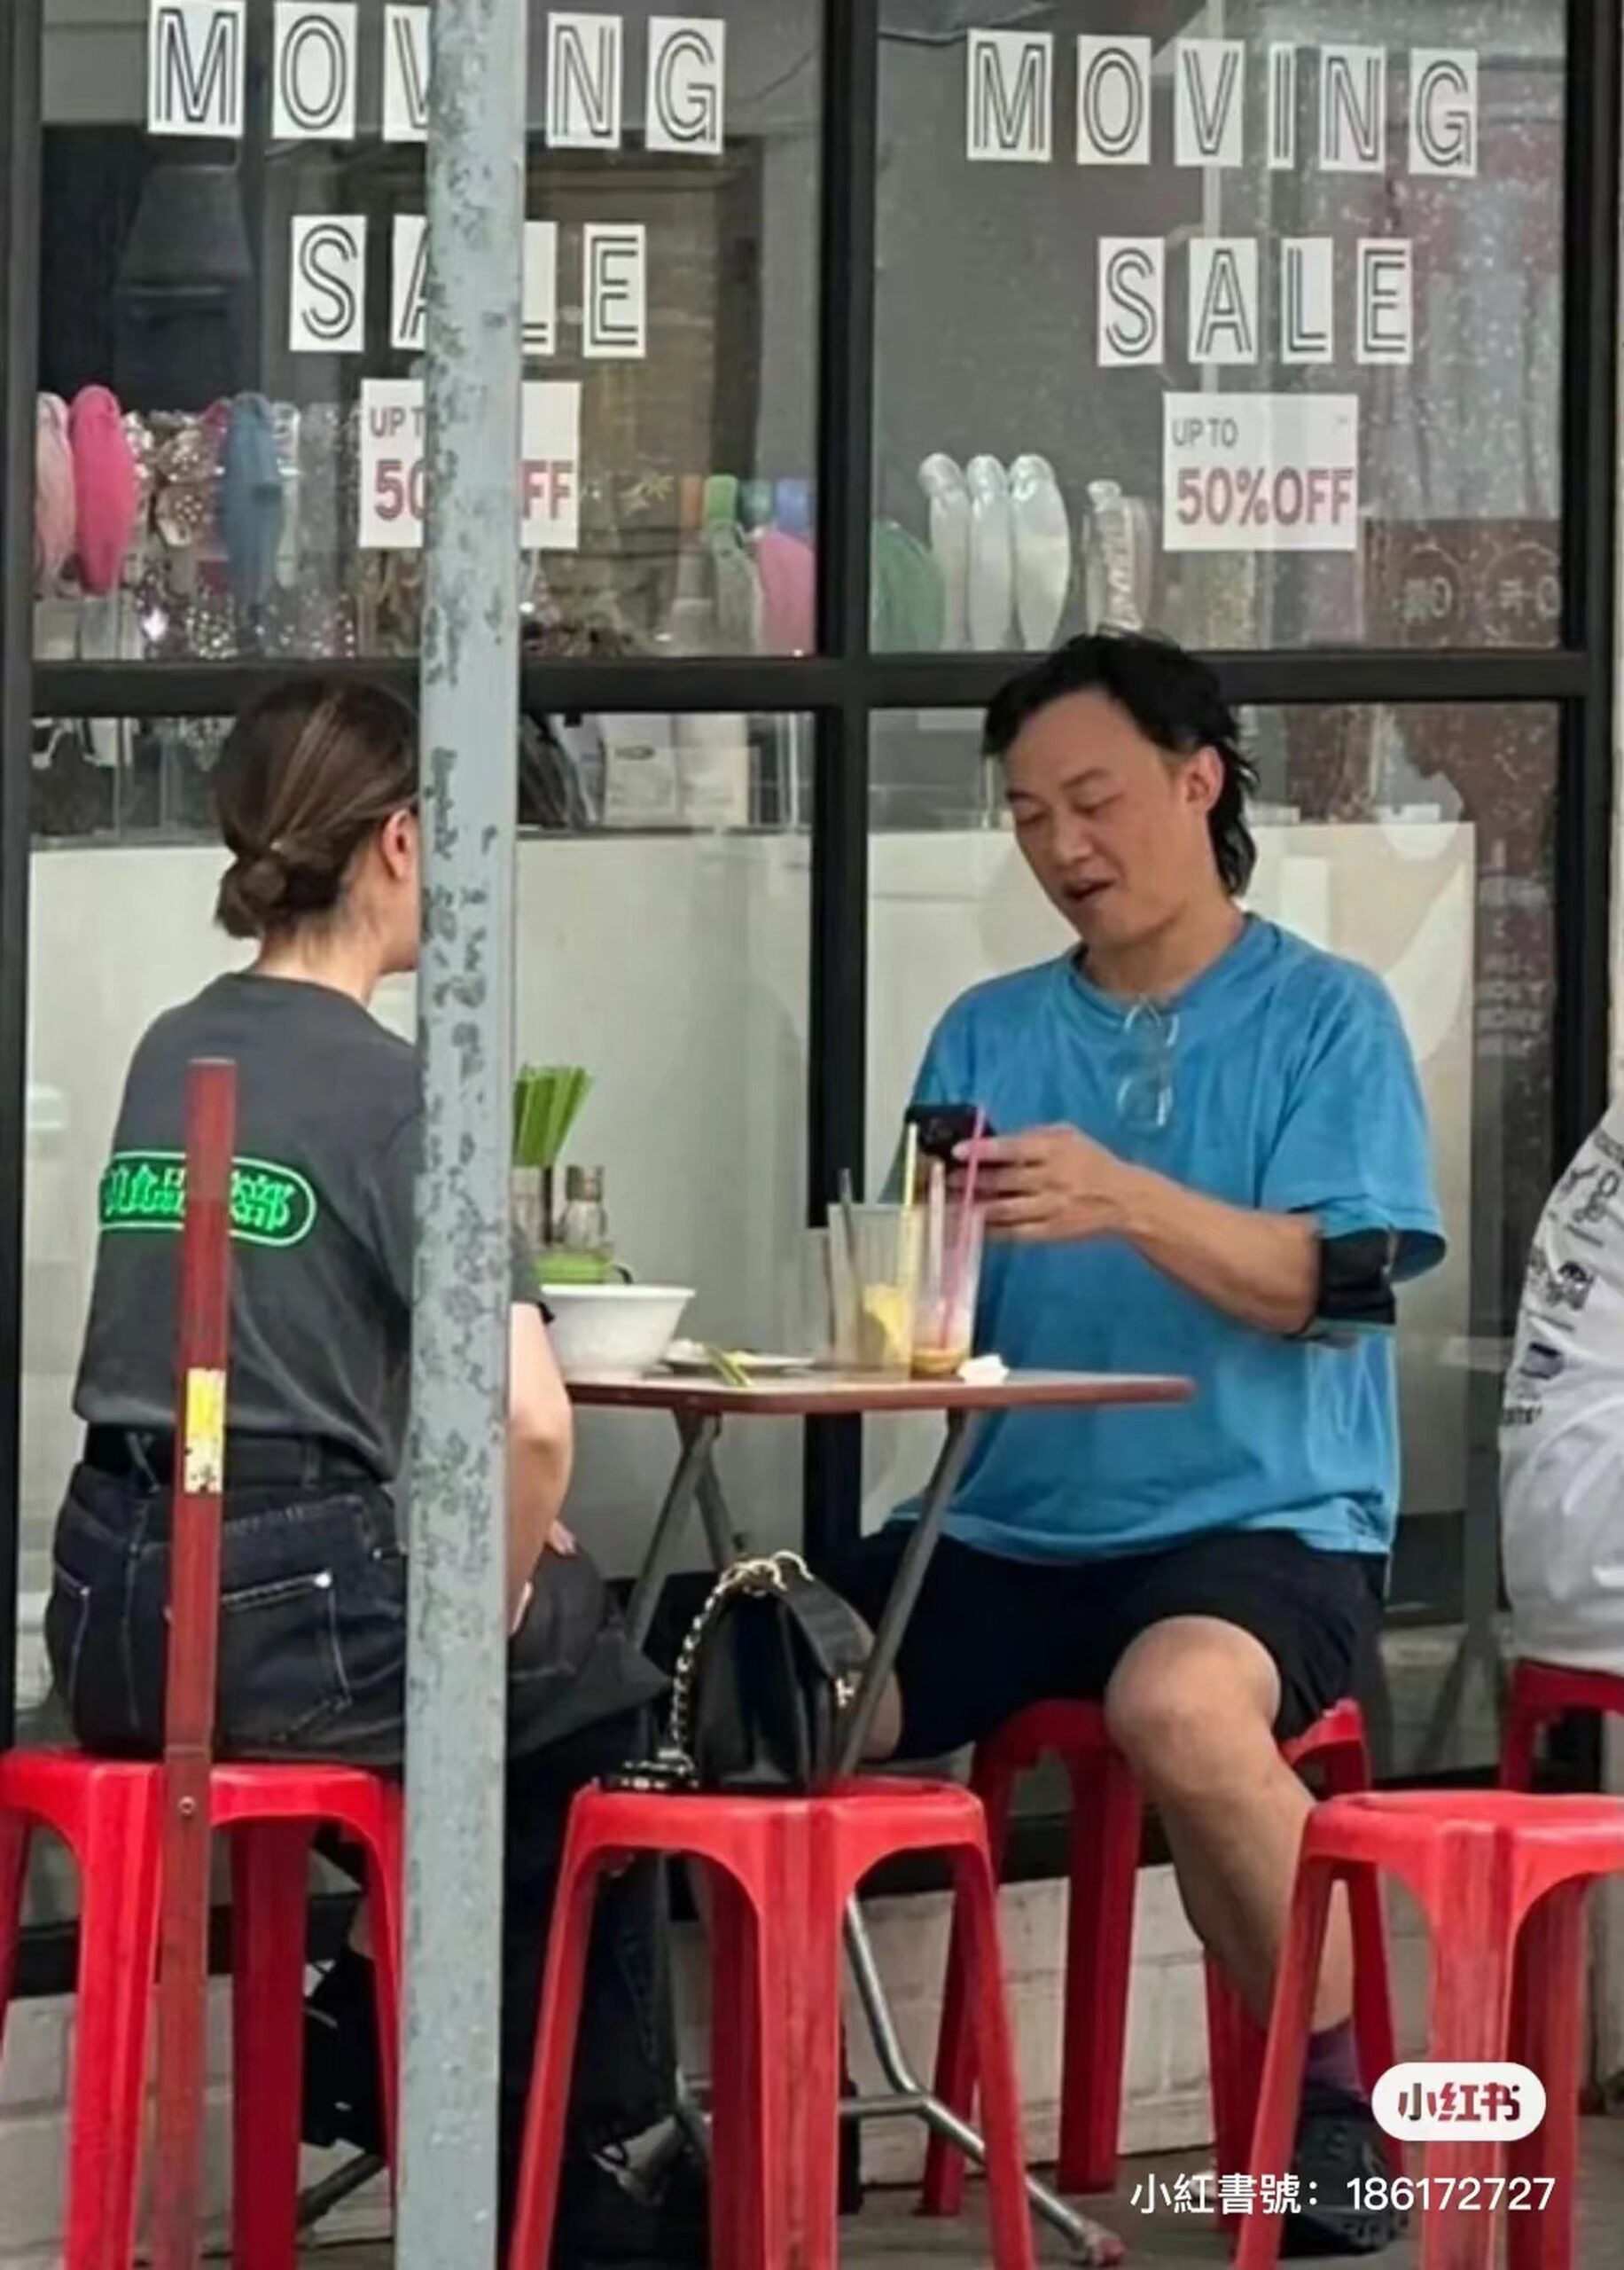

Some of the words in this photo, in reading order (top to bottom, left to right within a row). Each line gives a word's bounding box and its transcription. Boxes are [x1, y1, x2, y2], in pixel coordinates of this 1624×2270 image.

[152, 8, 717, 140] MOVNG
[973, 41, 1472, 167] MOVING
[1105, 247, 1408, 358] SALE
[370, 406, 406, 438] UP
[1172, 417, 1204, 447] UP
[1207, 417, 1239, 448] TO
[374, 458, 574, 521] 50FF
